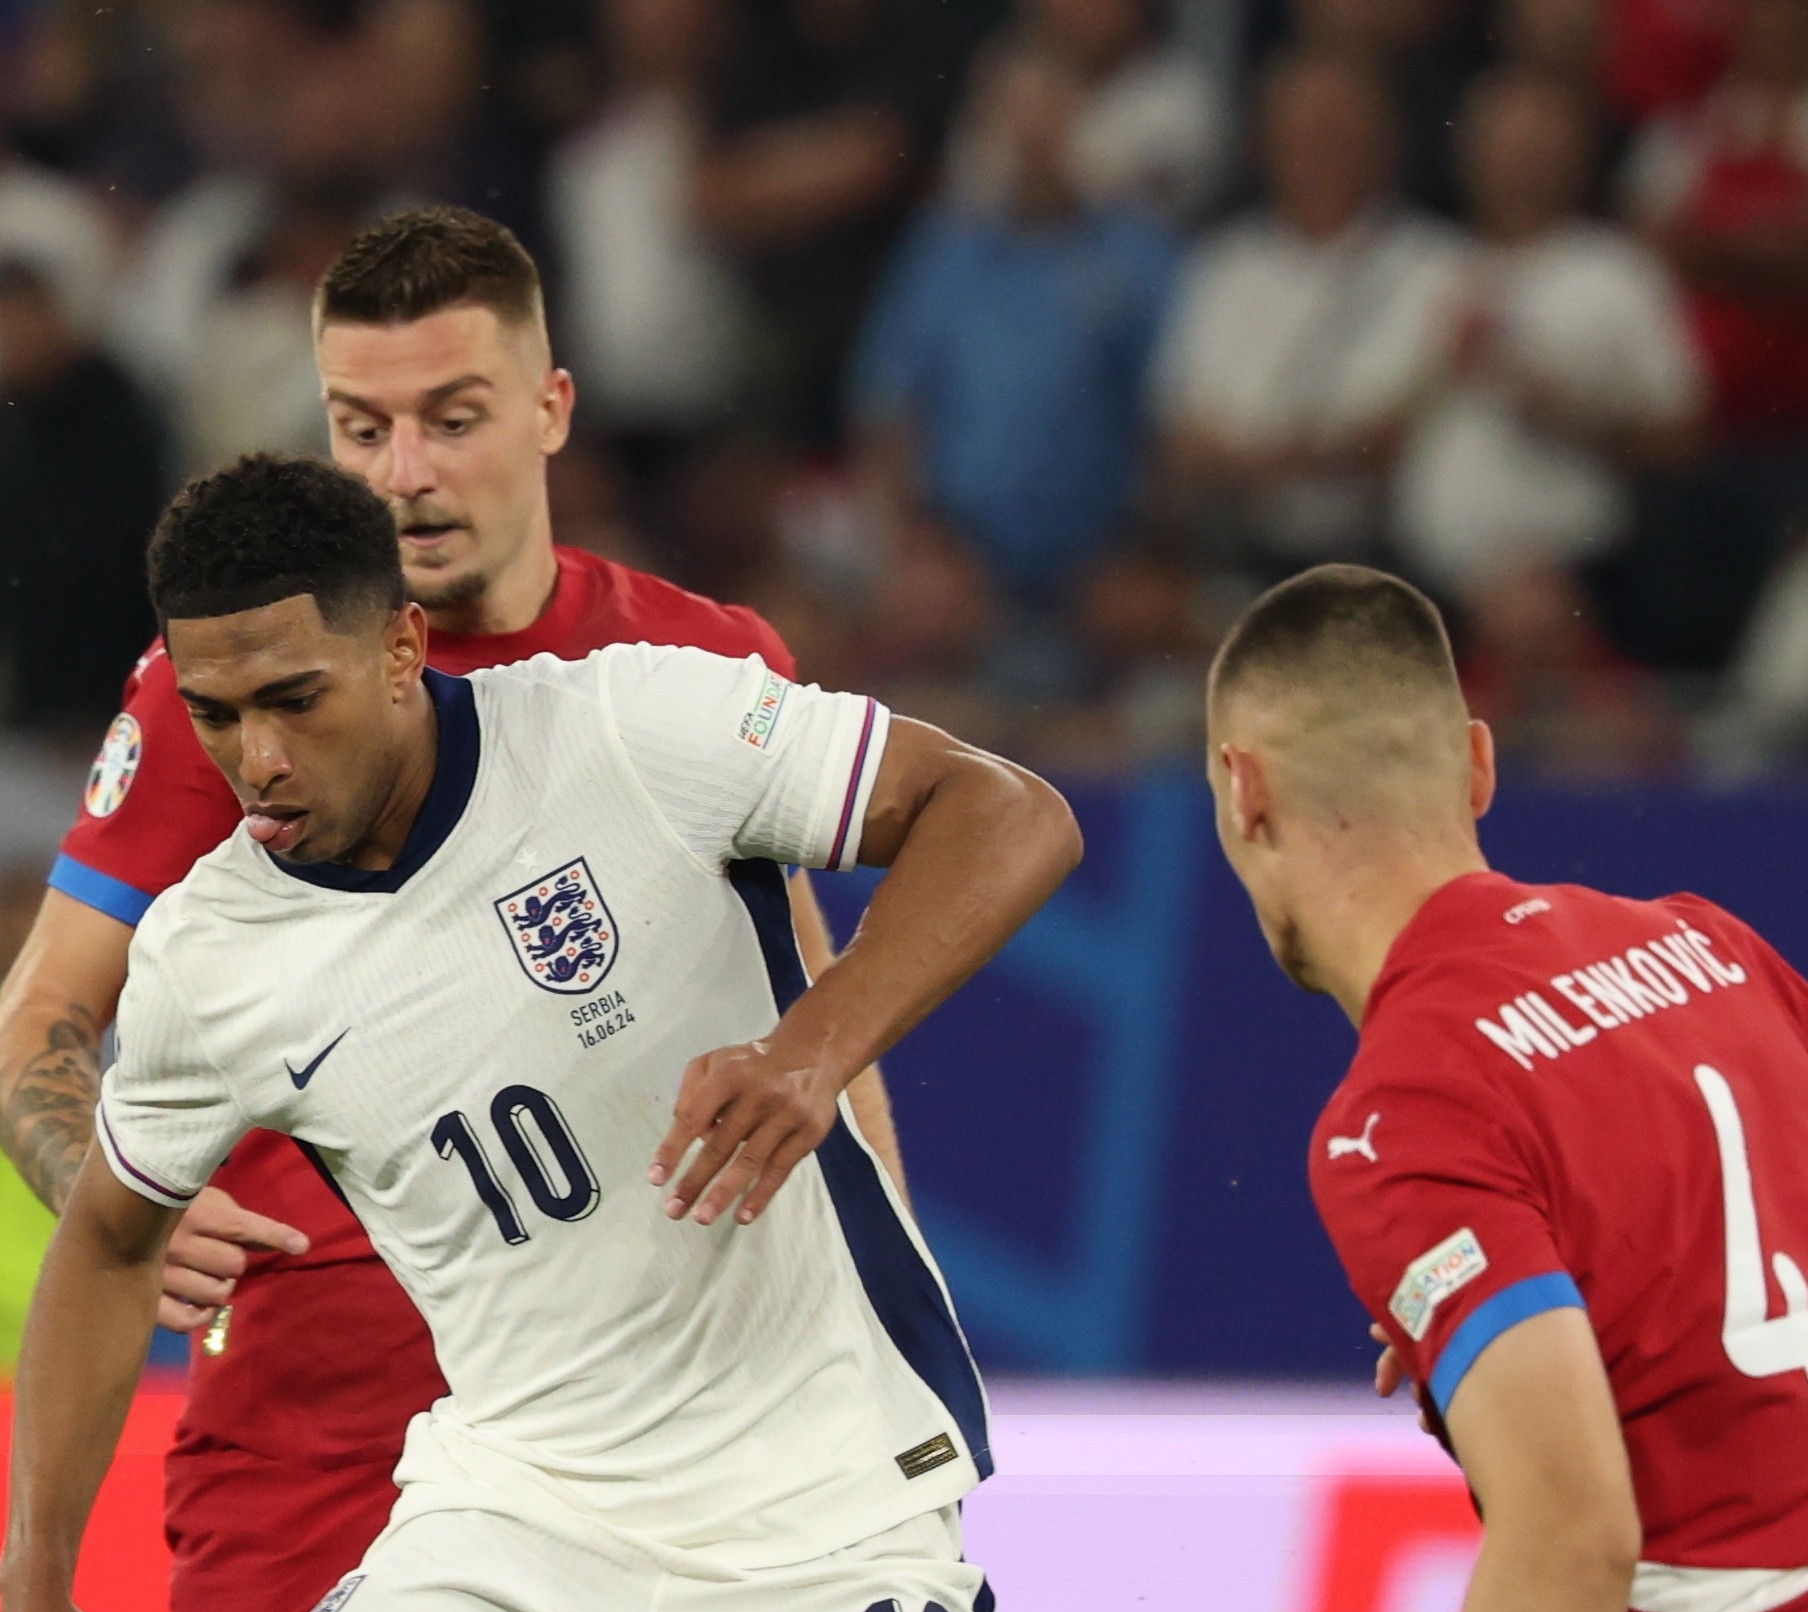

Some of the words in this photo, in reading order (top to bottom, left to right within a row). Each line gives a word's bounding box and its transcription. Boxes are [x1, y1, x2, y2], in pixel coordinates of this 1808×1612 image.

[747, 674, 786, 748] FOUNDA
[570, 990, 627, 1027] SERBIA
[577, 1008, 636, 1049] 16.06.24
[1475, 918, 1748, 1072] MILENKOVIĆ
[430, 1084, 601, 1246] 10
